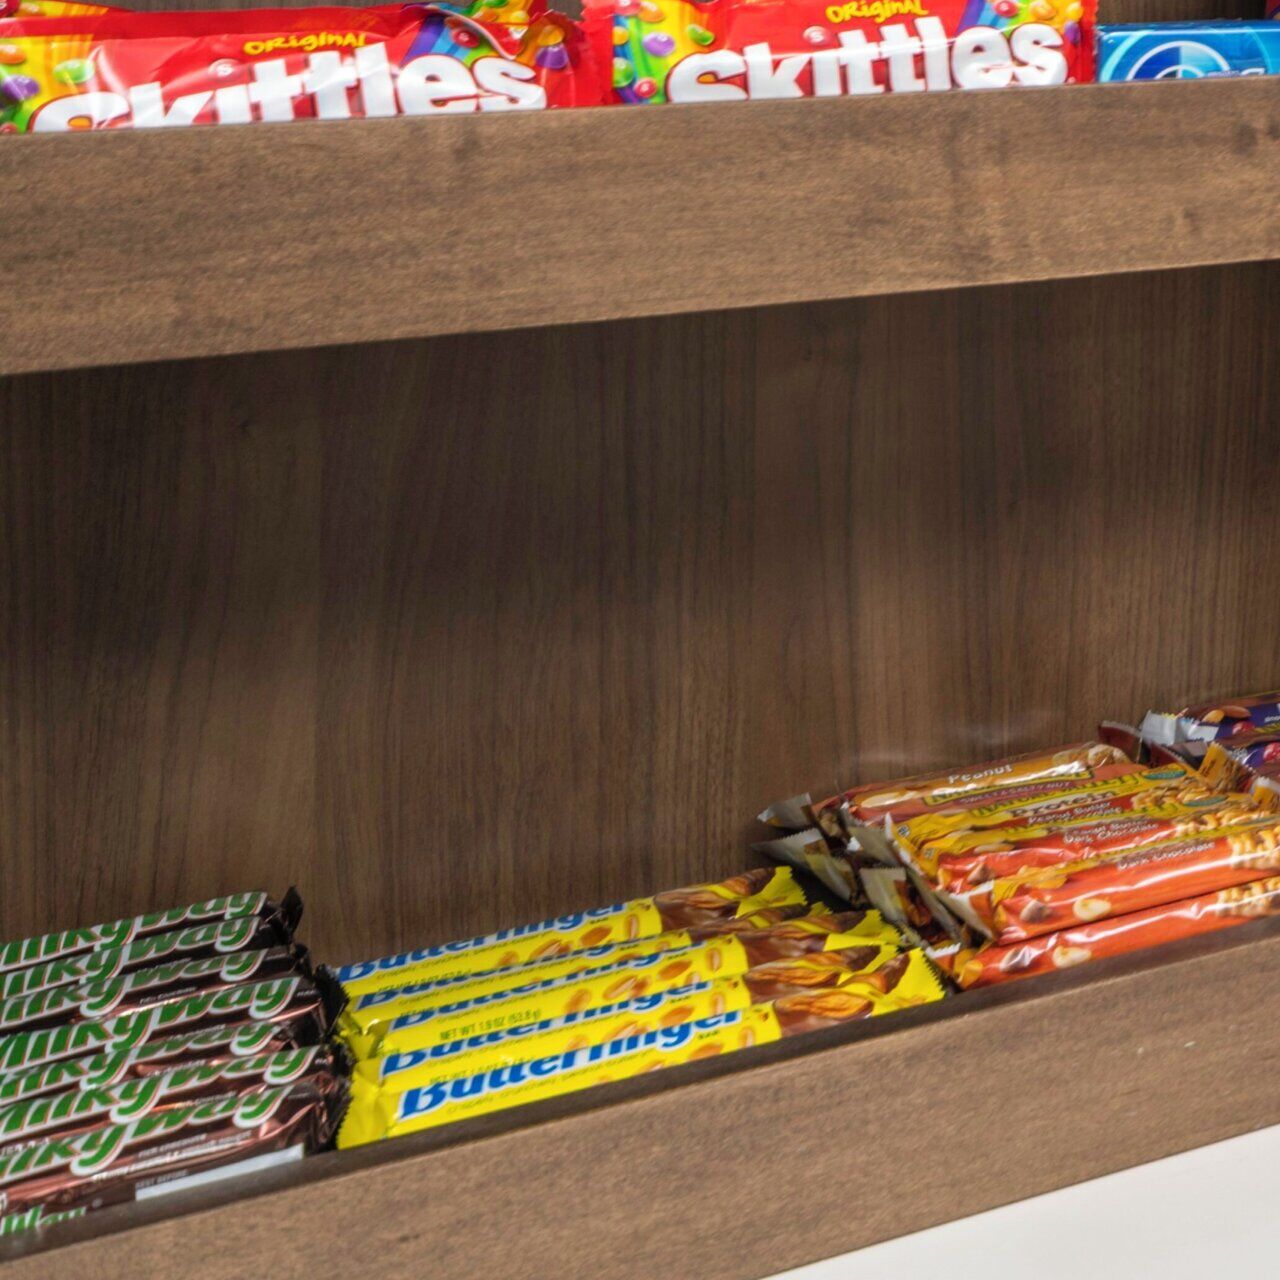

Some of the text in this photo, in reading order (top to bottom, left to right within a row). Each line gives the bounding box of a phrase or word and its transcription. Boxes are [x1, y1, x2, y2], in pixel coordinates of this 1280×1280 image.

[948, 764, 1013, 784] Peanut
[1150, 841, 1216, 863] Chocolate
[439, 1028, 460, 1042] NET
